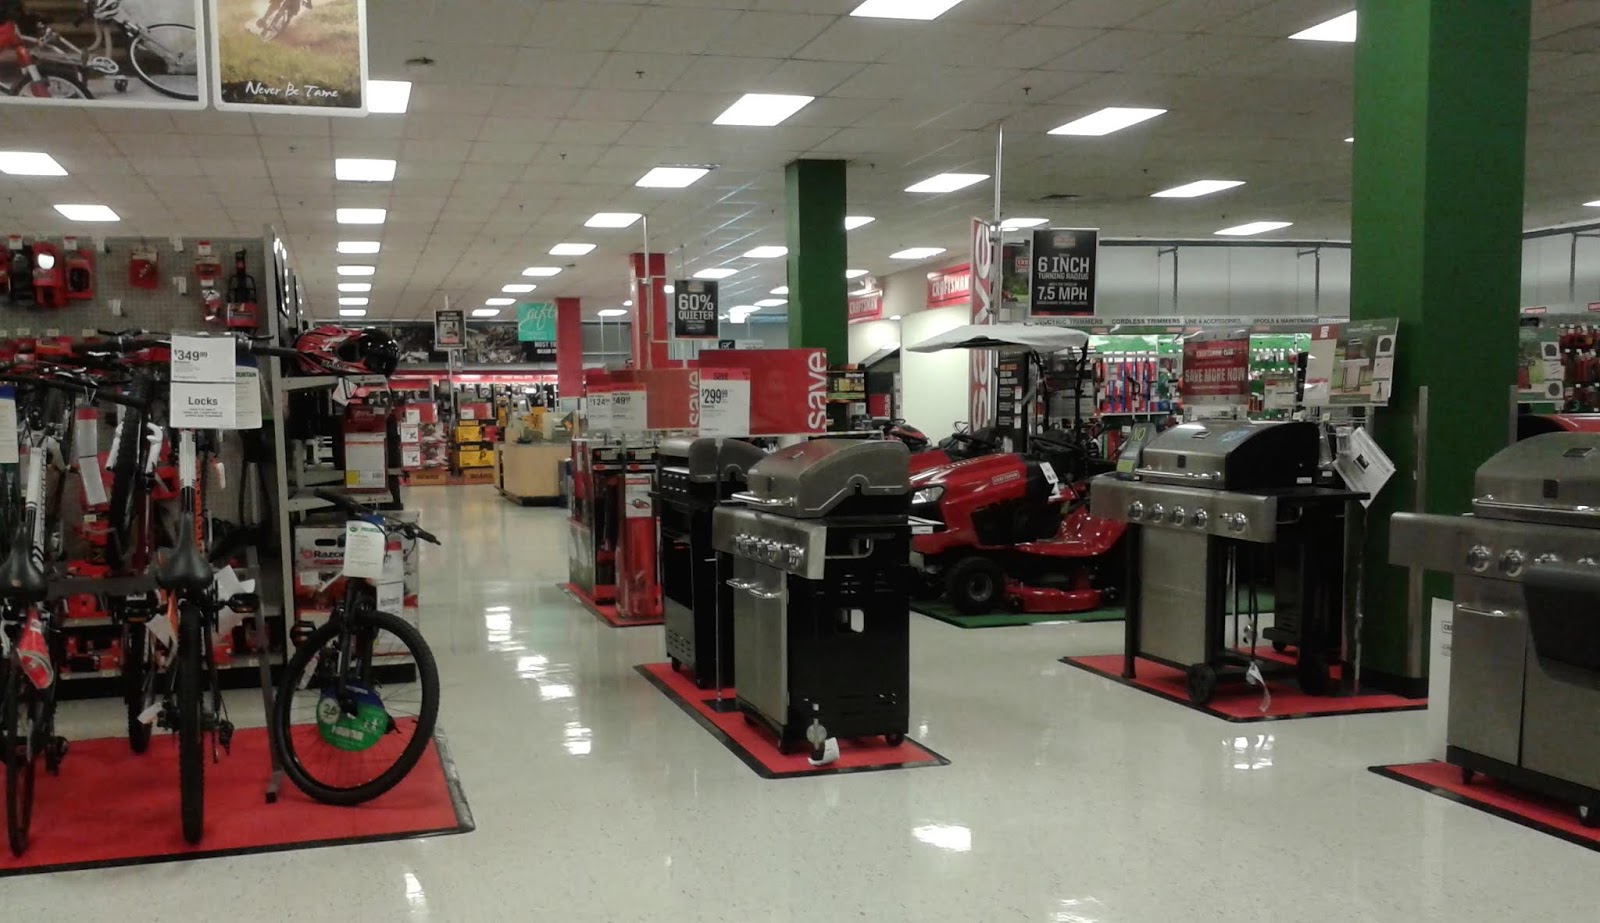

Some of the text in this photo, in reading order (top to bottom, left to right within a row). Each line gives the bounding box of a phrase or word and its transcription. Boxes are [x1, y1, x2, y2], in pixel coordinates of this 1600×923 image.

[245, 81, 338, 97] Never Be Tame
[1037, 256, 1048, 273] 6
[1051, 256, 1090, 273] INCH
[1038, 272, 1089, 280] TURNING RADIUS
[1037, 286, 1088, 301] 7.5 MPH
[678, 293, 714, 311] 60%
[678, 311, 714, 320] QUIETER
[1185, 367, 1246, 382] SAVE MORE NOW
[689, 371, 700, 425] save
[806, 351, 827, 431] save
[188, 396, 218, 406] Locks
